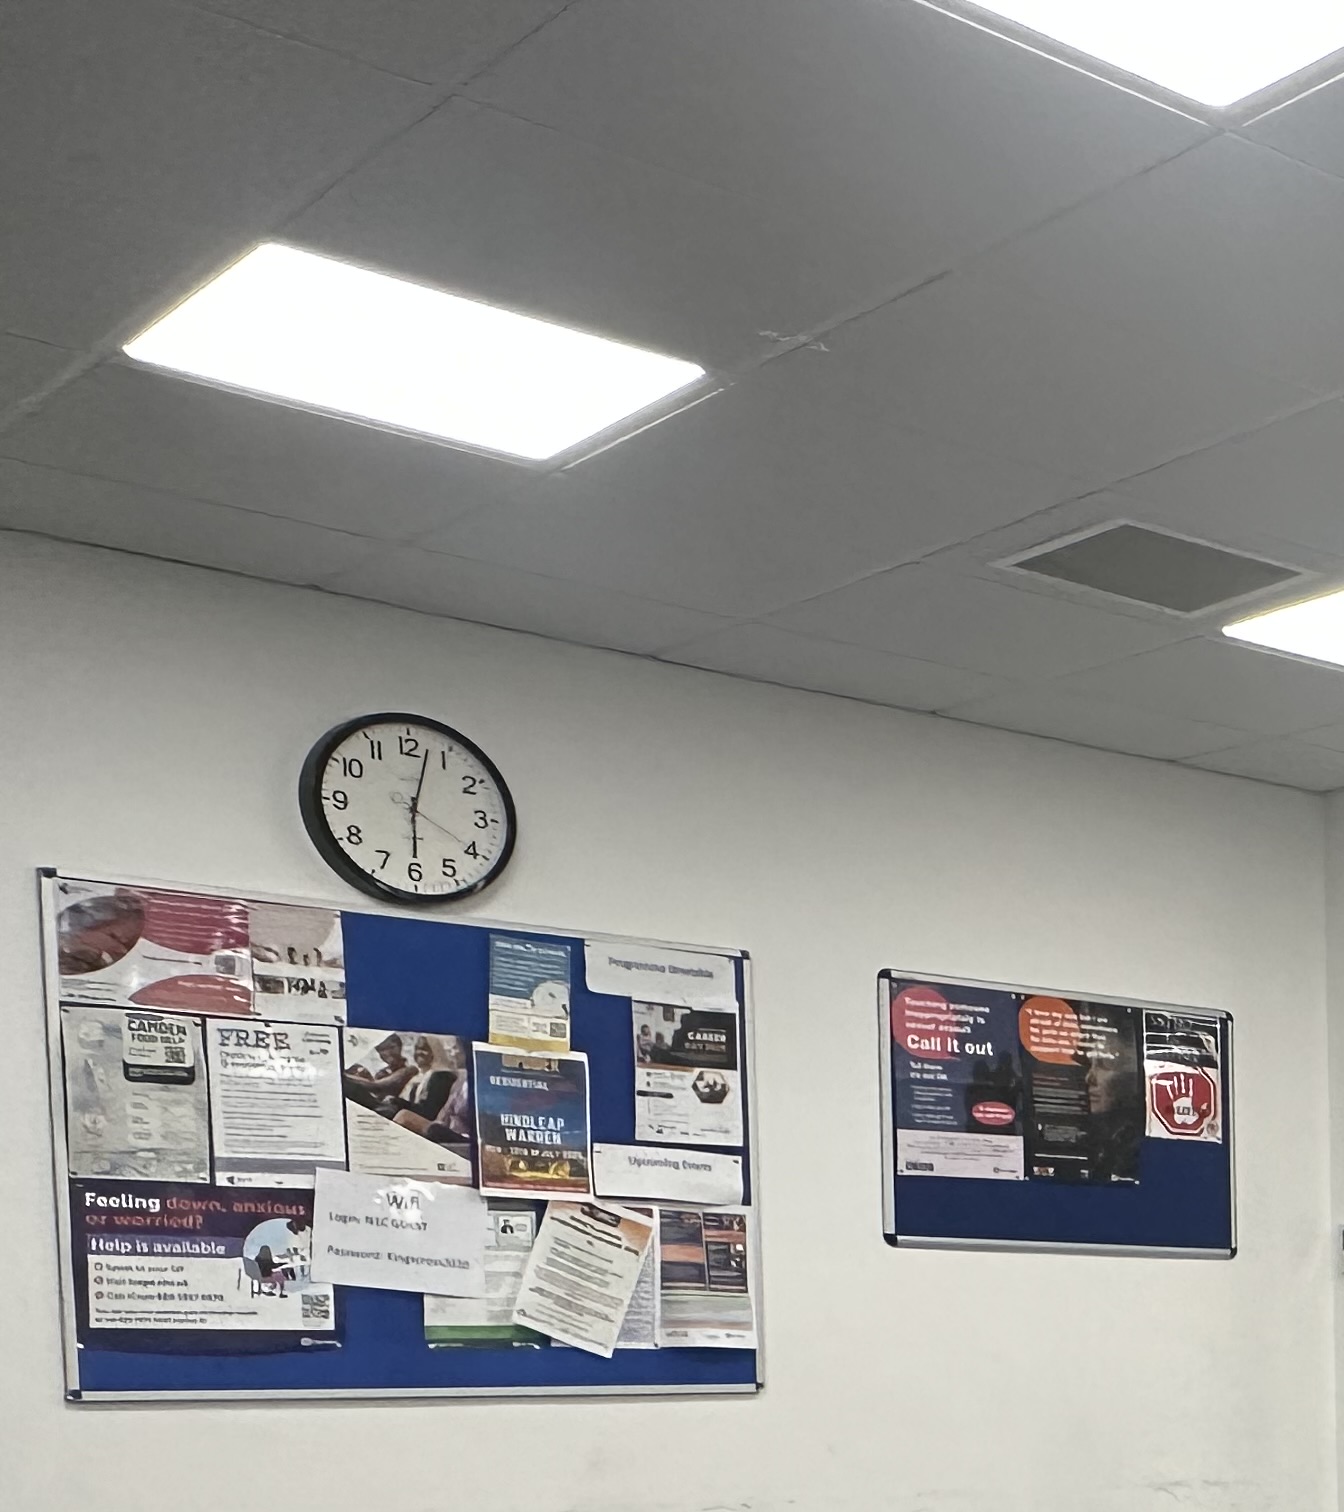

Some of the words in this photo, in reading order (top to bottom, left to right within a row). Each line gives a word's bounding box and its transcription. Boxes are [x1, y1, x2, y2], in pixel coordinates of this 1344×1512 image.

[369, 739, 382, 761] 11
[398, 735, 421, 758] 12
[342, 757, 364, 779] 10
[440, 750, 447, 770] 1
[461, 775, 477, 795] 2
[331, 790, 349, 810] 9
[473, 810, 489, 829] 3
[346, 824, 363, 846] 8
[375, 849, 391, 870] 7
[463, 840, 478, 860] 4
[407, 862, 423, 882] 6
[442, 858, 457, 878] 5
[216, 1027, 292, 1050] FREE
[906, 1034, 942, 1052] Call
[947, 1036, 960, 1053] it
[964, 1041, 994, 1056] out
[84, 1192, 161, 1213] Feeling
[166, 1196, 227, 1212] down,
[232, 1200, 306, 1216] anxious
[85, 1215, 107, 1226] or
[113, 1214, 204, 1230] worried?
[90, 1236, 132, 1254] Help
[136, 1239, 149, 1254] is
[153, 1240, 226, 1255] available
